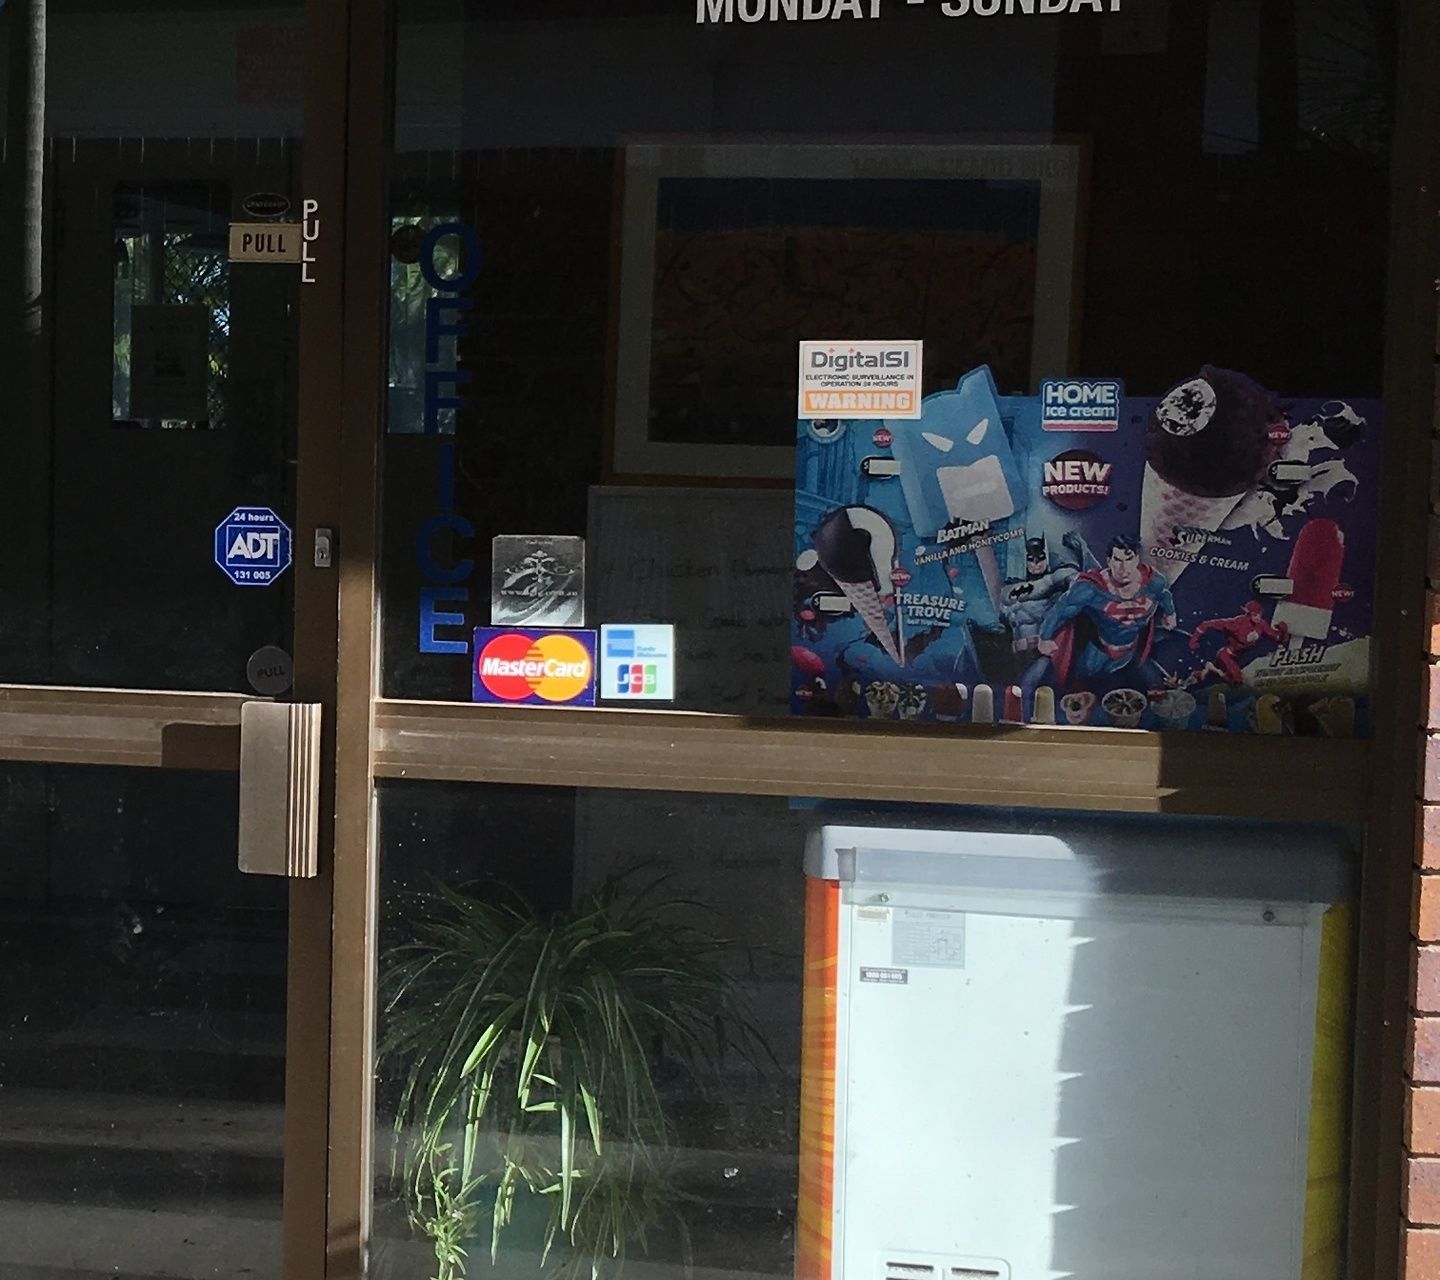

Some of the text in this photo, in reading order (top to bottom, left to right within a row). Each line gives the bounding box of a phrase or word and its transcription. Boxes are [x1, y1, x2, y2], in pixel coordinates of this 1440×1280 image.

[242, 233, 286, 253] PULL
[302, 199, 320, 283] PULL
[805, 373, 849, 381] ELECTRONIC
[852, 373, 905, 381] SURVEILLANCE
[808, 392, 910, 410] WARNING
[1046, 385, 1116, 404] HOME
[1069, 407, 1115, 417] cream
[418, 223, 481, 654] OFFICE
[1044, 461, 1112, 482] NEW
[1042, 484, 1109, 496] PRODUCTS!
[234, 513, 274, 521] 24 hours
[936, 520, 989, 543] BATMAN
[228, 532, 280, 559] ADT
[914, 528, 1024, 566] VANILLA AND HONEYCOMB
[1150, 547, 1250, 571] COOKIES & CREAM
[234, 570, 250, 579] 131
[895, 593, 966, 611] TREASURE
[907, 605, 952, 620] TROVE
[482, 658, 587, 677] MasterCard
[617, 664, 657, 693] JCB
